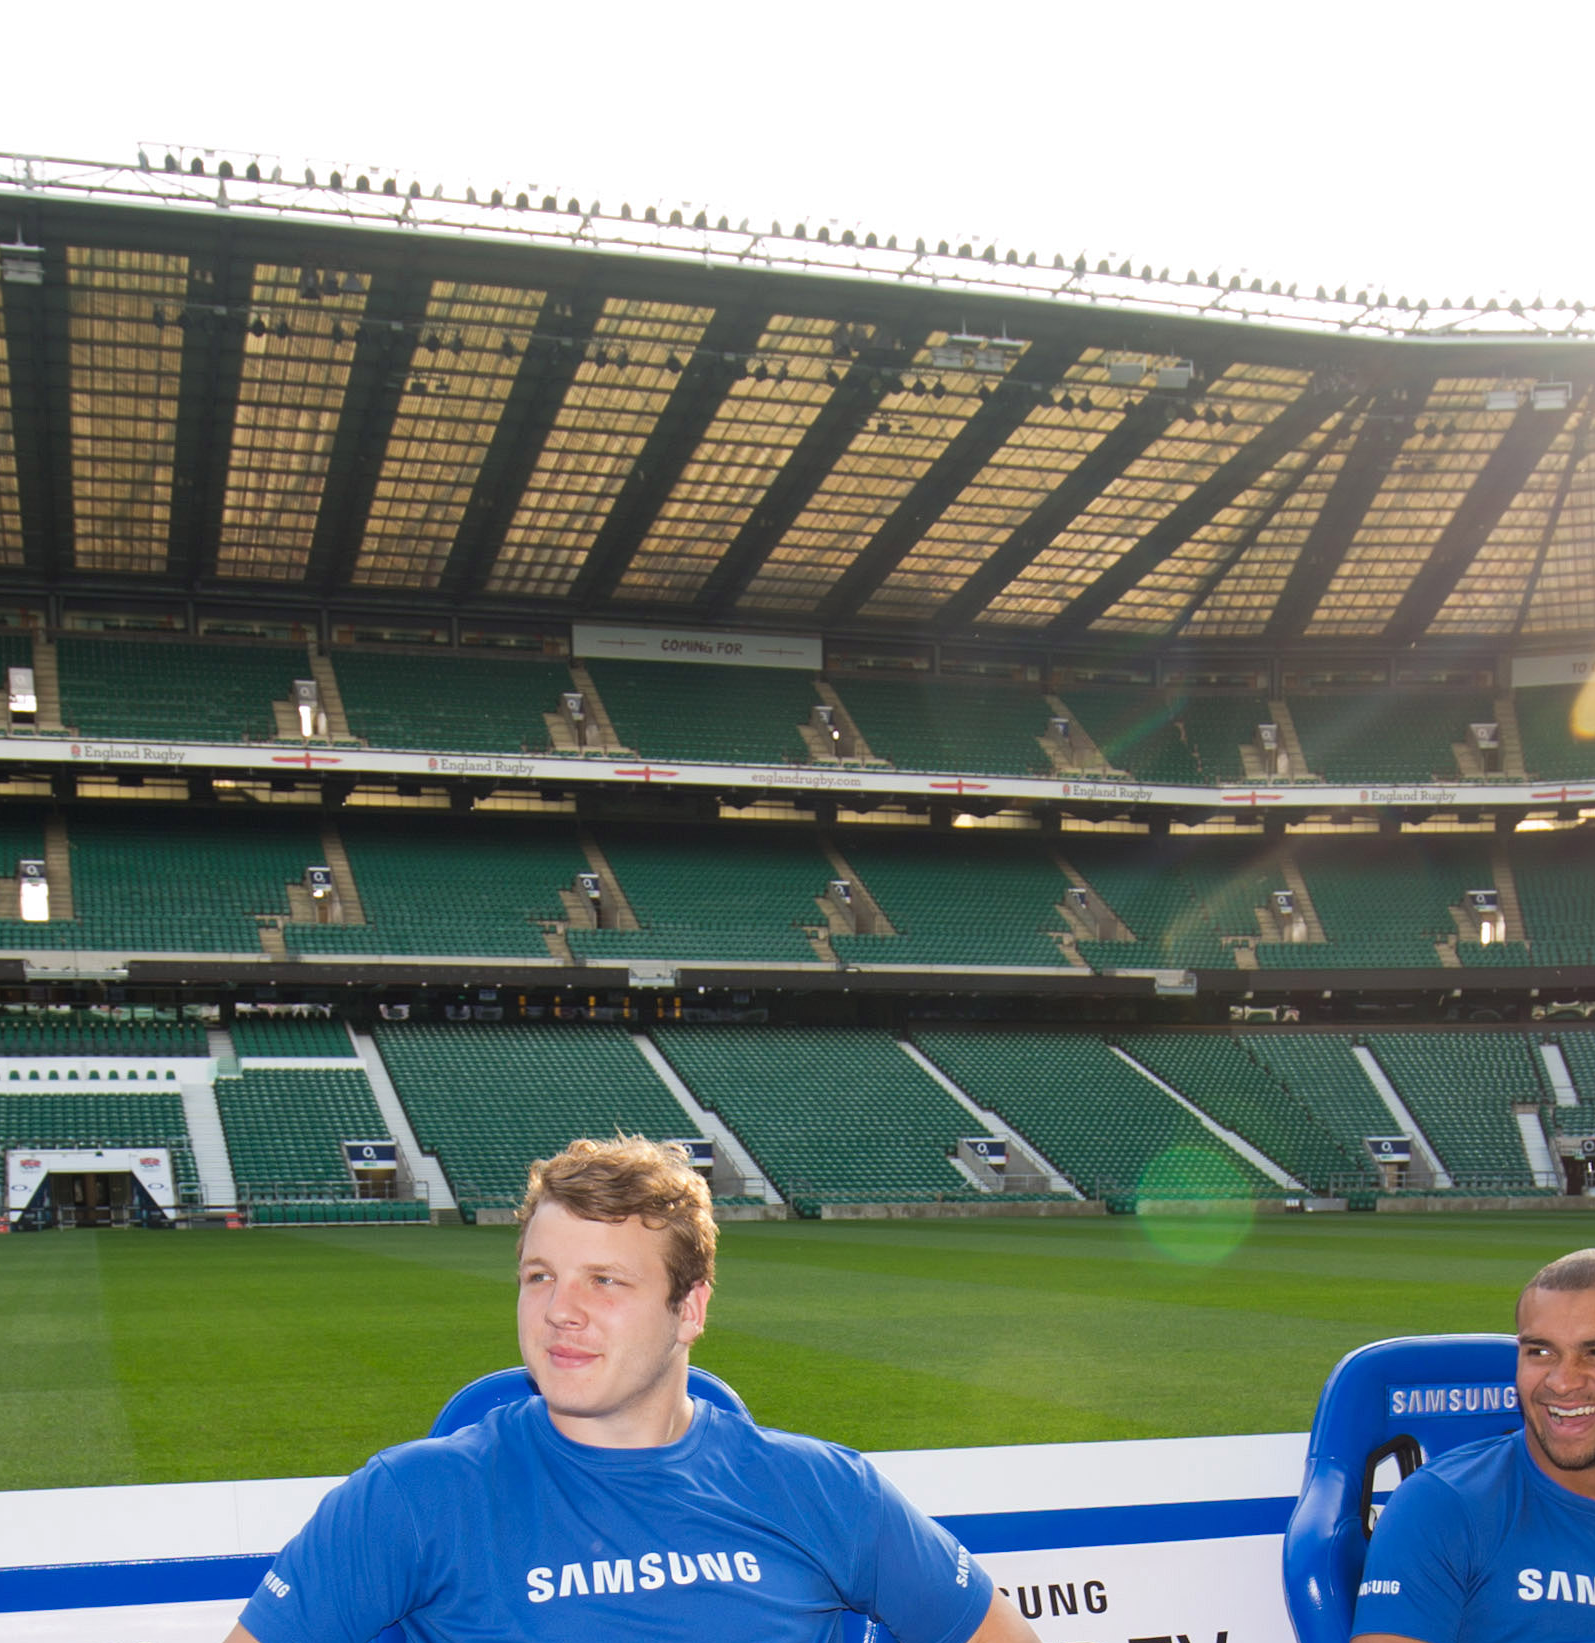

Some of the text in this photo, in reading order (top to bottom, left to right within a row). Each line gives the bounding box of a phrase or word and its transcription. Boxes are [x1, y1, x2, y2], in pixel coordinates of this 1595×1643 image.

[660, 640, 743, 655] COMING FOR
[84, 746, 186, 762] England Rugby
[440, 758, 535, 774] England Rugby
[751, 772, 862, 787] englandrugby.com
[1072, 785, 1153, 800] England Rugby
[1371, 791, 1457, 803] England Rugby
[1392, 1386, 1519, 1414] SAMSUNG
[526, 1551, 761, 1603] SAMSUNG
